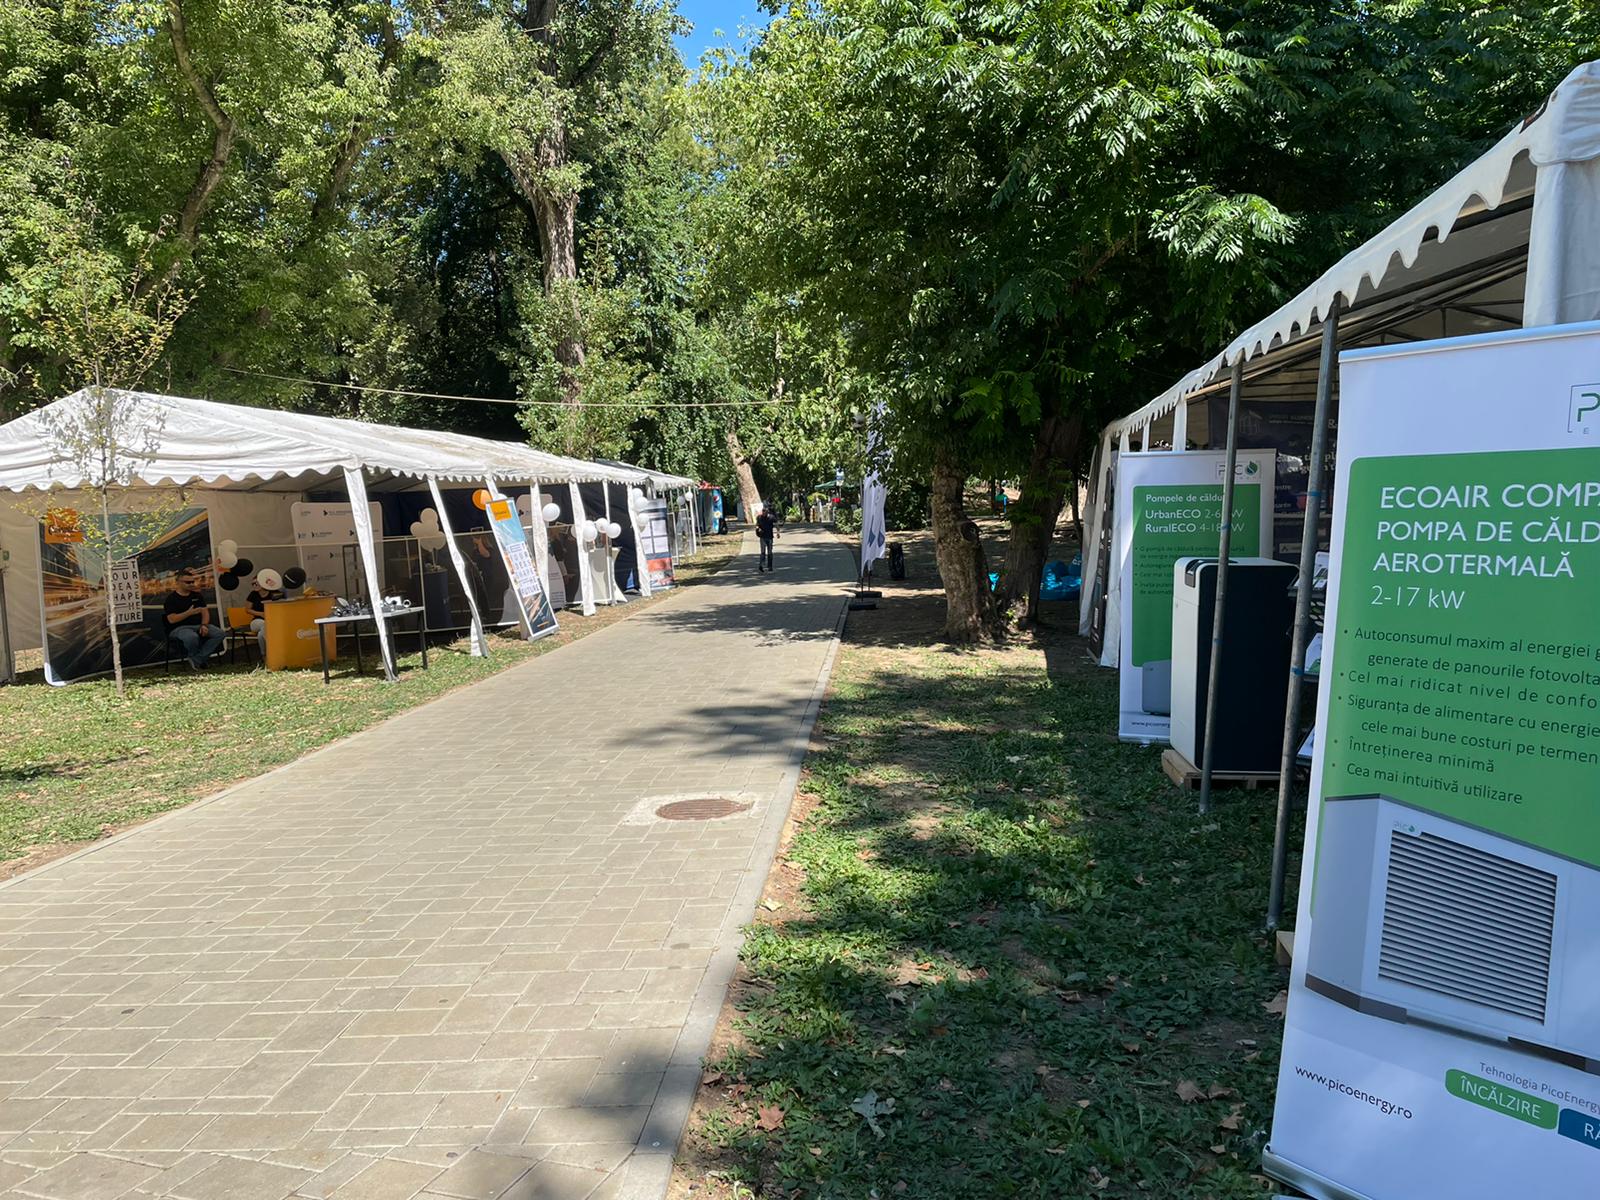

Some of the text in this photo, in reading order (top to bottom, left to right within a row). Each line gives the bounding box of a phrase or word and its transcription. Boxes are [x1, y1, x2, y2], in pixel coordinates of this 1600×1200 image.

[1145, 494, 1224, 504] Pompele de căldu
[1380, 482, 1600, 508] ECOAIR COMP
[1145, 509, 1201, 519] UrbanECO
[1145, 523, 1197, 533] RuralECO
[1377, 516, 1600, 543] POMPA DE CĂLD
[1372, 551, 1574, 577] AEROTERMALĂ
[1371, 585, 1465, 609] 2-17 kW
[1354, 627, 1452, 646] Autoconsumul
[1456, 637, 1505, 650] maxim
[1509, 639, 1522, 652] al
[1527, 642, 1590, 659] energiei
[1367, 654, 1428, 668] generate
[1432, 658, 1450, 671] de
[1454, 662, 1525, 678] panourile
[1348, 670, 1370, 683] Cel
[1376, 675, 1403, 687] mai
[1410, 678, 1462, 694] ridicat
[1469, 684, 1510, 699] nivel
[1518, 688, 1538, 702] de
[1413, 702, 1431, 715] de
[1434, 705, 1514, 726] alimentare
[1518, 717, 1536, 729] cu
[1361, 721, 1598, 765] cele mai bune costuri pe termen
[1438, 754, 1495, 773] minimă
[1347, 763, 1523, 804] Cea mai intuitivă utilizare
[1480, 1062, 1538, 1090] Tehnologia
[1295, 1066, 1412, 1119] www.picoenergy.ro
[1460, 1075, 1542, 1120] ÎNCĂLZIRE
